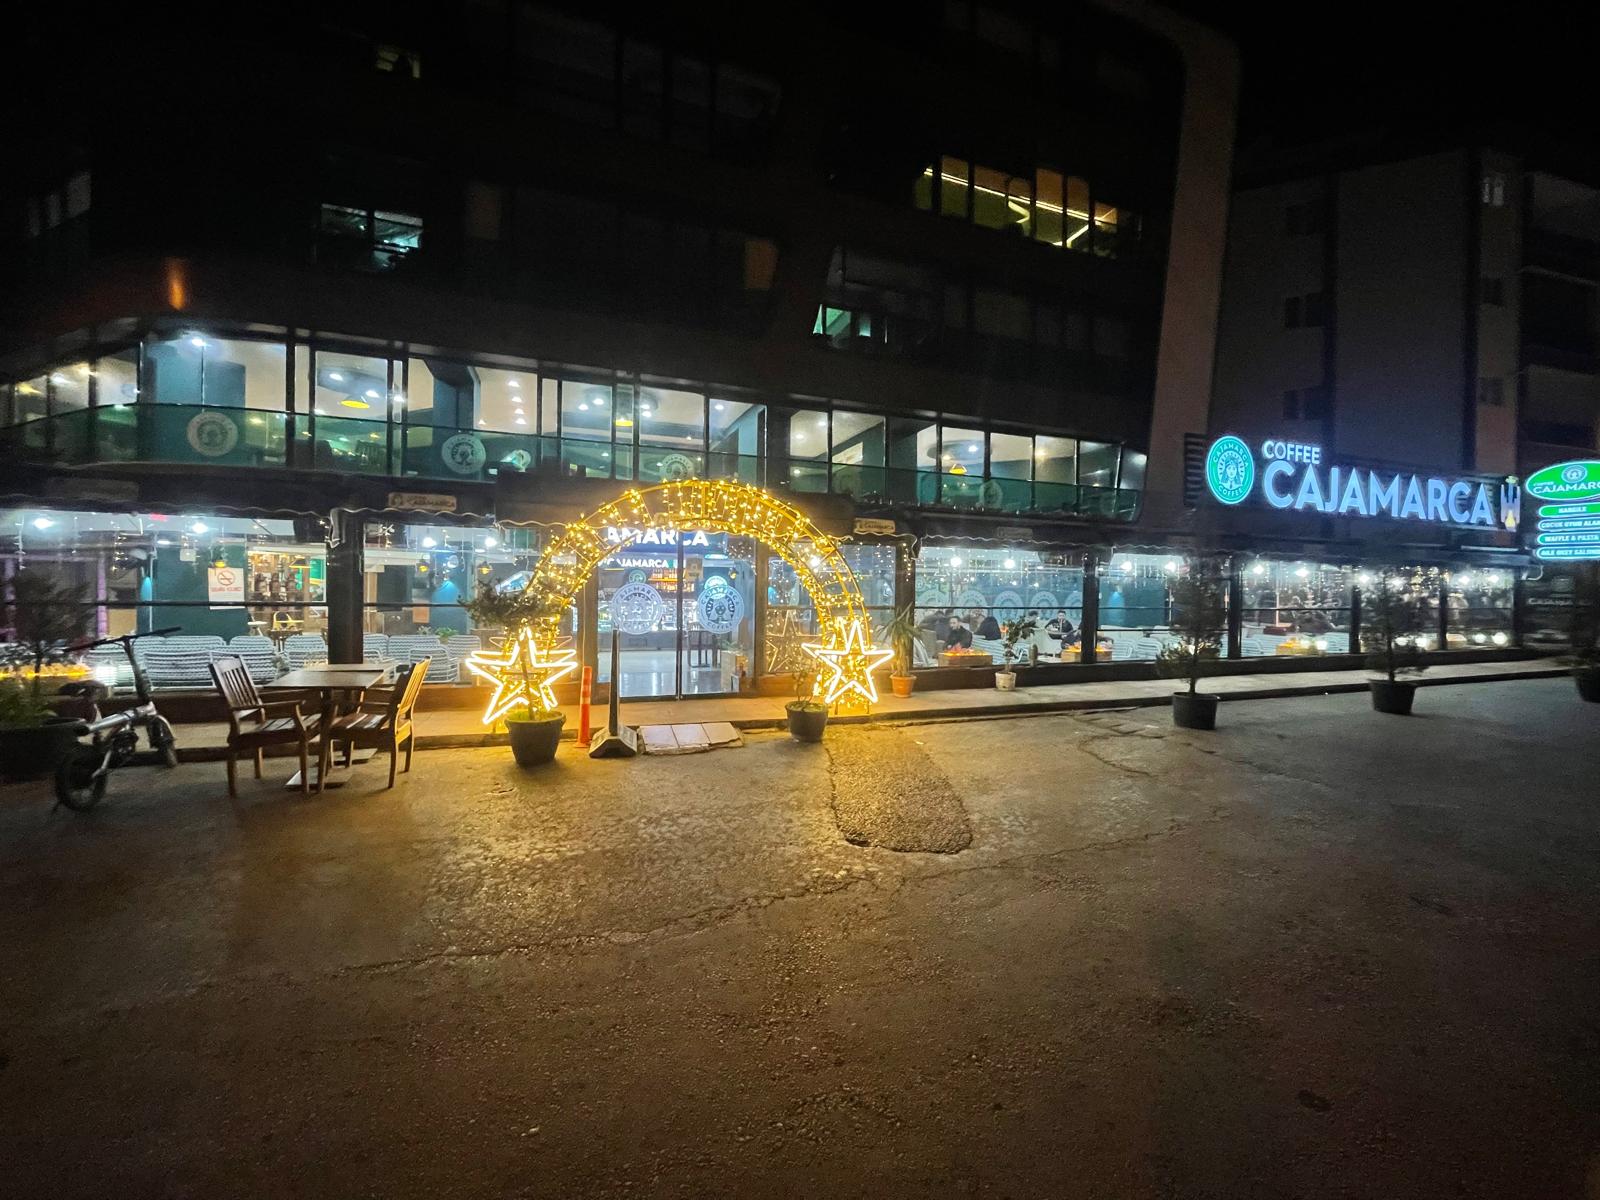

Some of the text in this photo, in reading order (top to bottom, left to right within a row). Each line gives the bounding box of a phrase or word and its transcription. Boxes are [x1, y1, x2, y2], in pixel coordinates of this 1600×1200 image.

[1212, 443, 1249, 468] CAJAMARCA
[1263, 440, 1322, 465] COFFEE
[1218, 485, 1244, 497] COFFEE
[1263, 460, 1495, 526] CAJAMARCA
